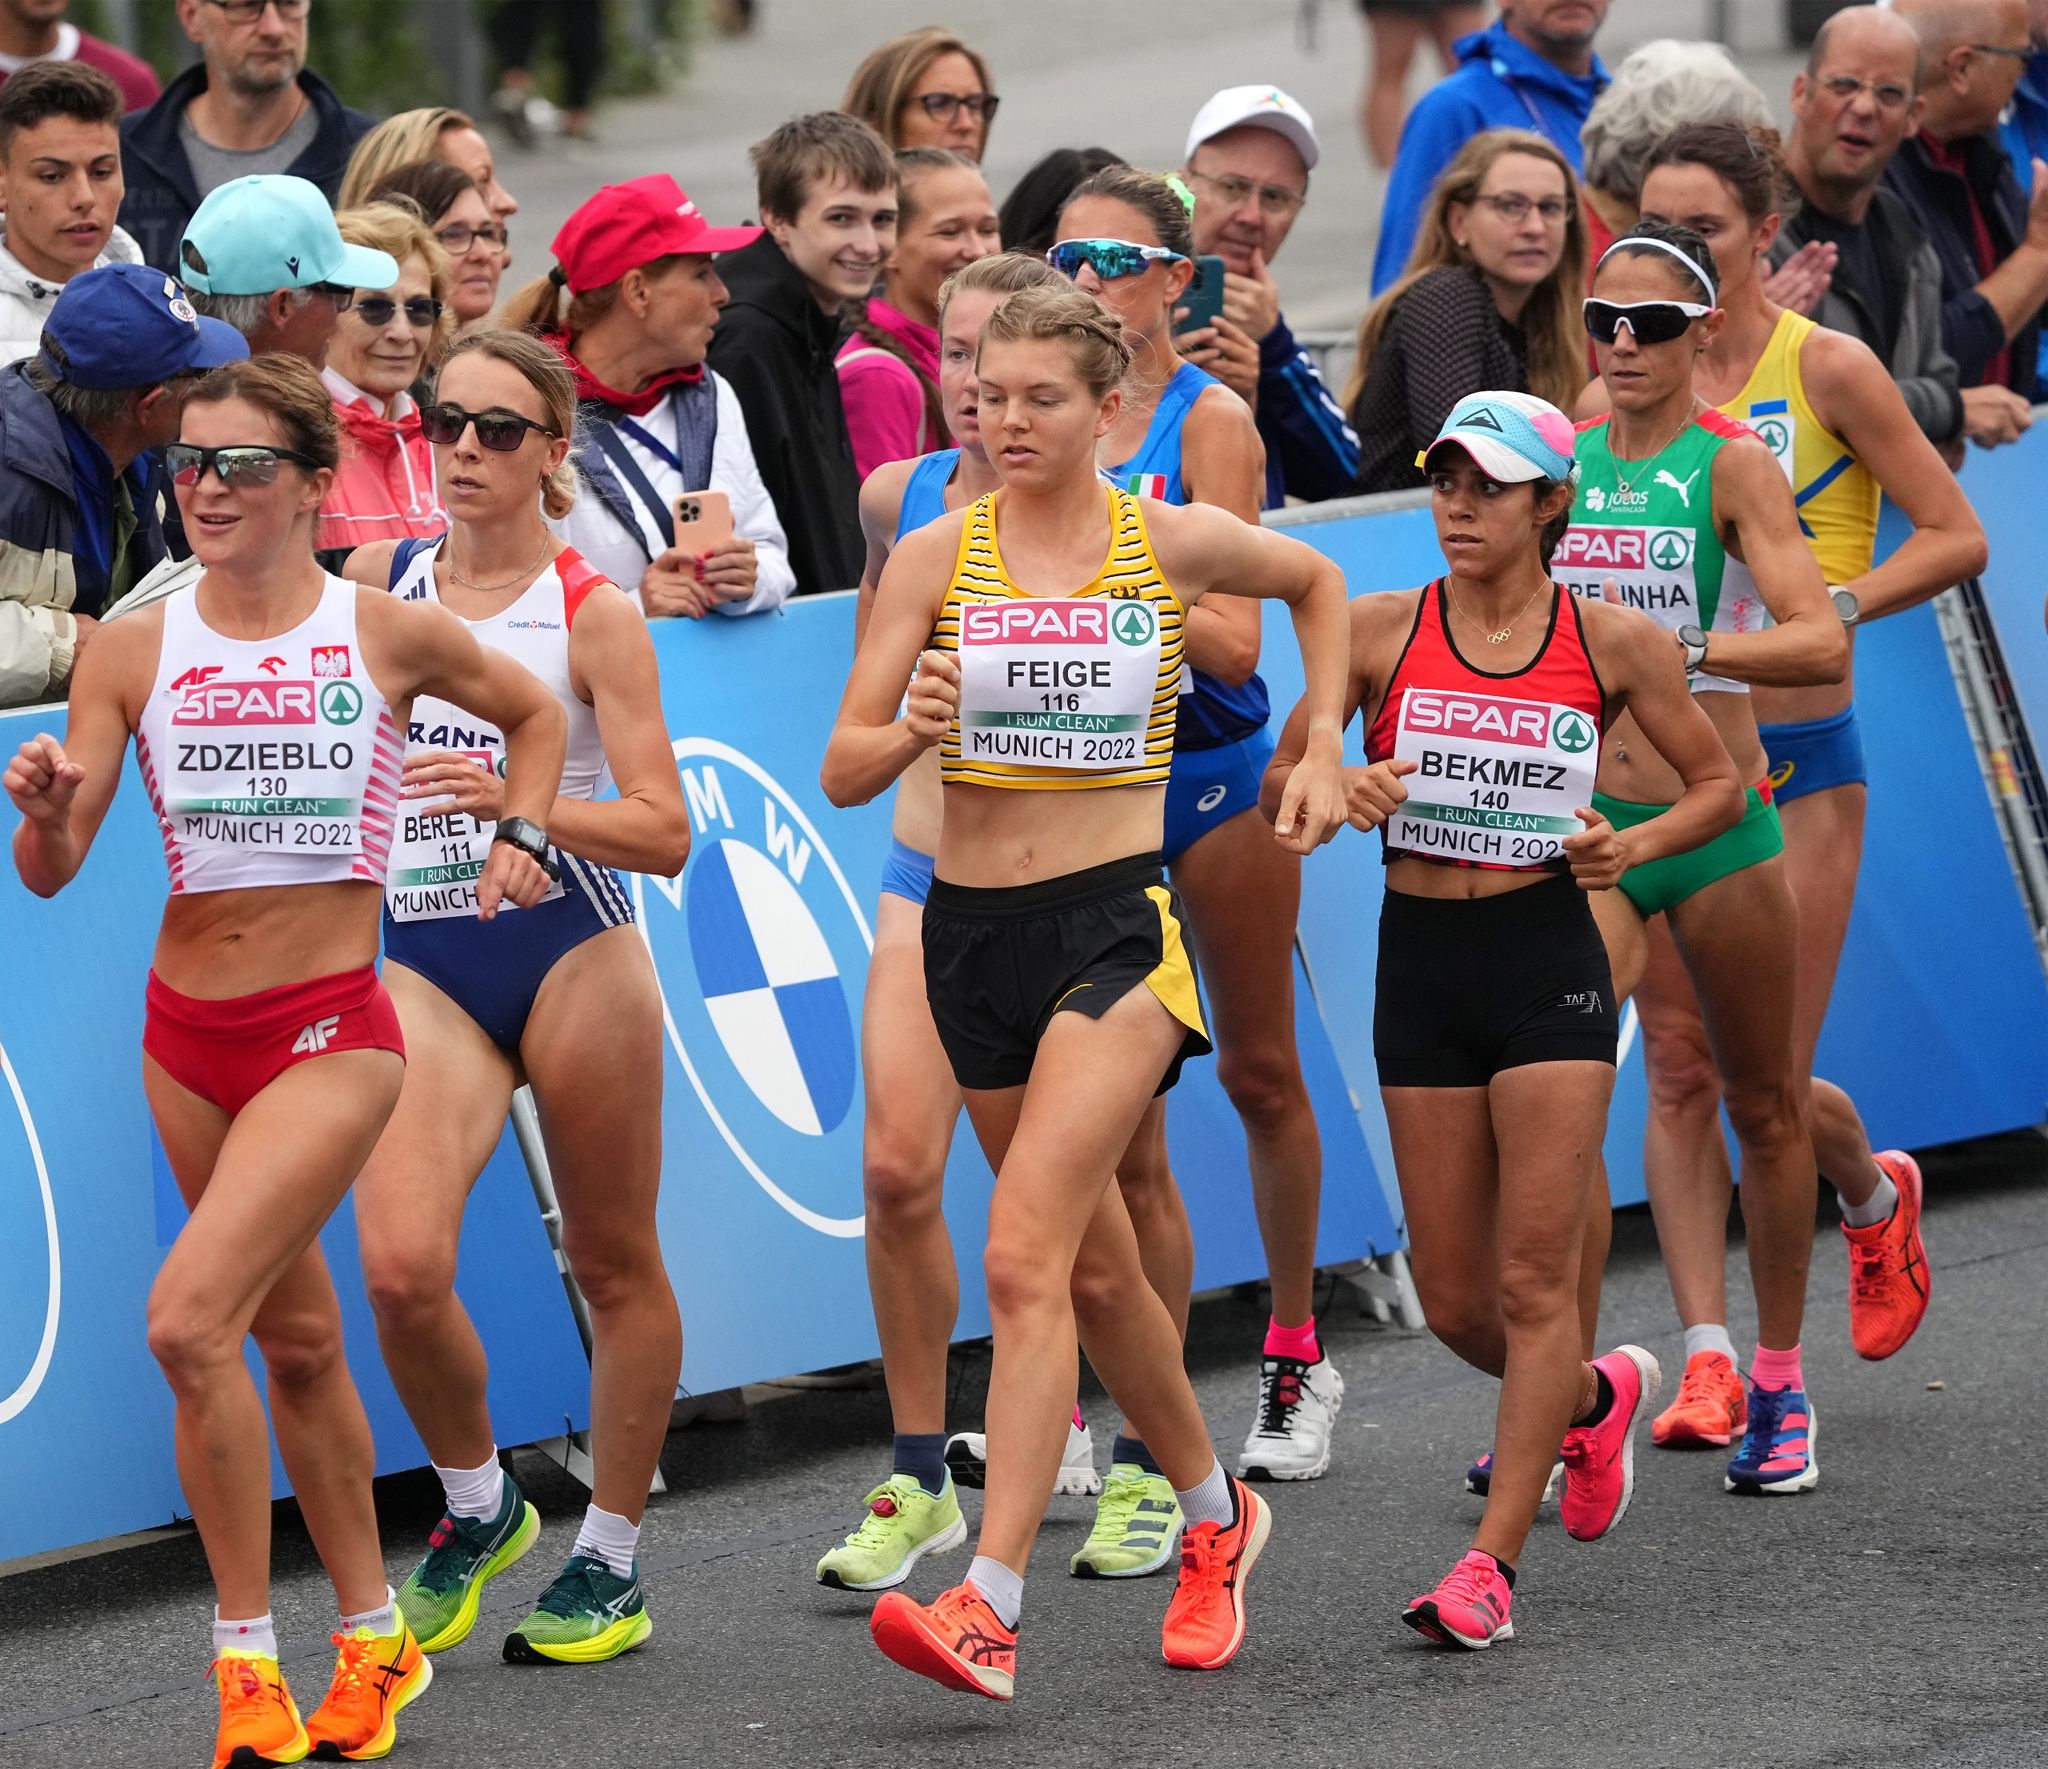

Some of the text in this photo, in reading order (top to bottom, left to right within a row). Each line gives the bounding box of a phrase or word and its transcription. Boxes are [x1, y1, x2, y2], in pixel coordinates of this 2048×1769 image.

[967, 607, 1103, 640] SPAR
[1007, 661, 1111, 688] FEIGE
[176, 684, 312, 720] SPAR
[1040, 693, 1080, 712] 116
[1016, 714, 1050, 728] RUN
[1409, 697, 1546, 742] SPAR
[177, 742, 353, 772] ZDZIEBLO
[973, 731, 1136, 761] MUNICH 2022
[1420, 750, 1567, 791] BEKMEZ
[246, 777, 288, 797] 130
[1469, 789, 1510, 811] 140
[221, 801, 259, 814] RUN
[1444, 807, 1480, 824] RUN
[185, 817, 352, 846] MUNICH 2022
[1401, 821, 1565, 860] MUNICH 202
[440, 841, 471, 864] 111
[427, 868, 453, 882] RUN
[393, 886, 480, 914] MUNICH
